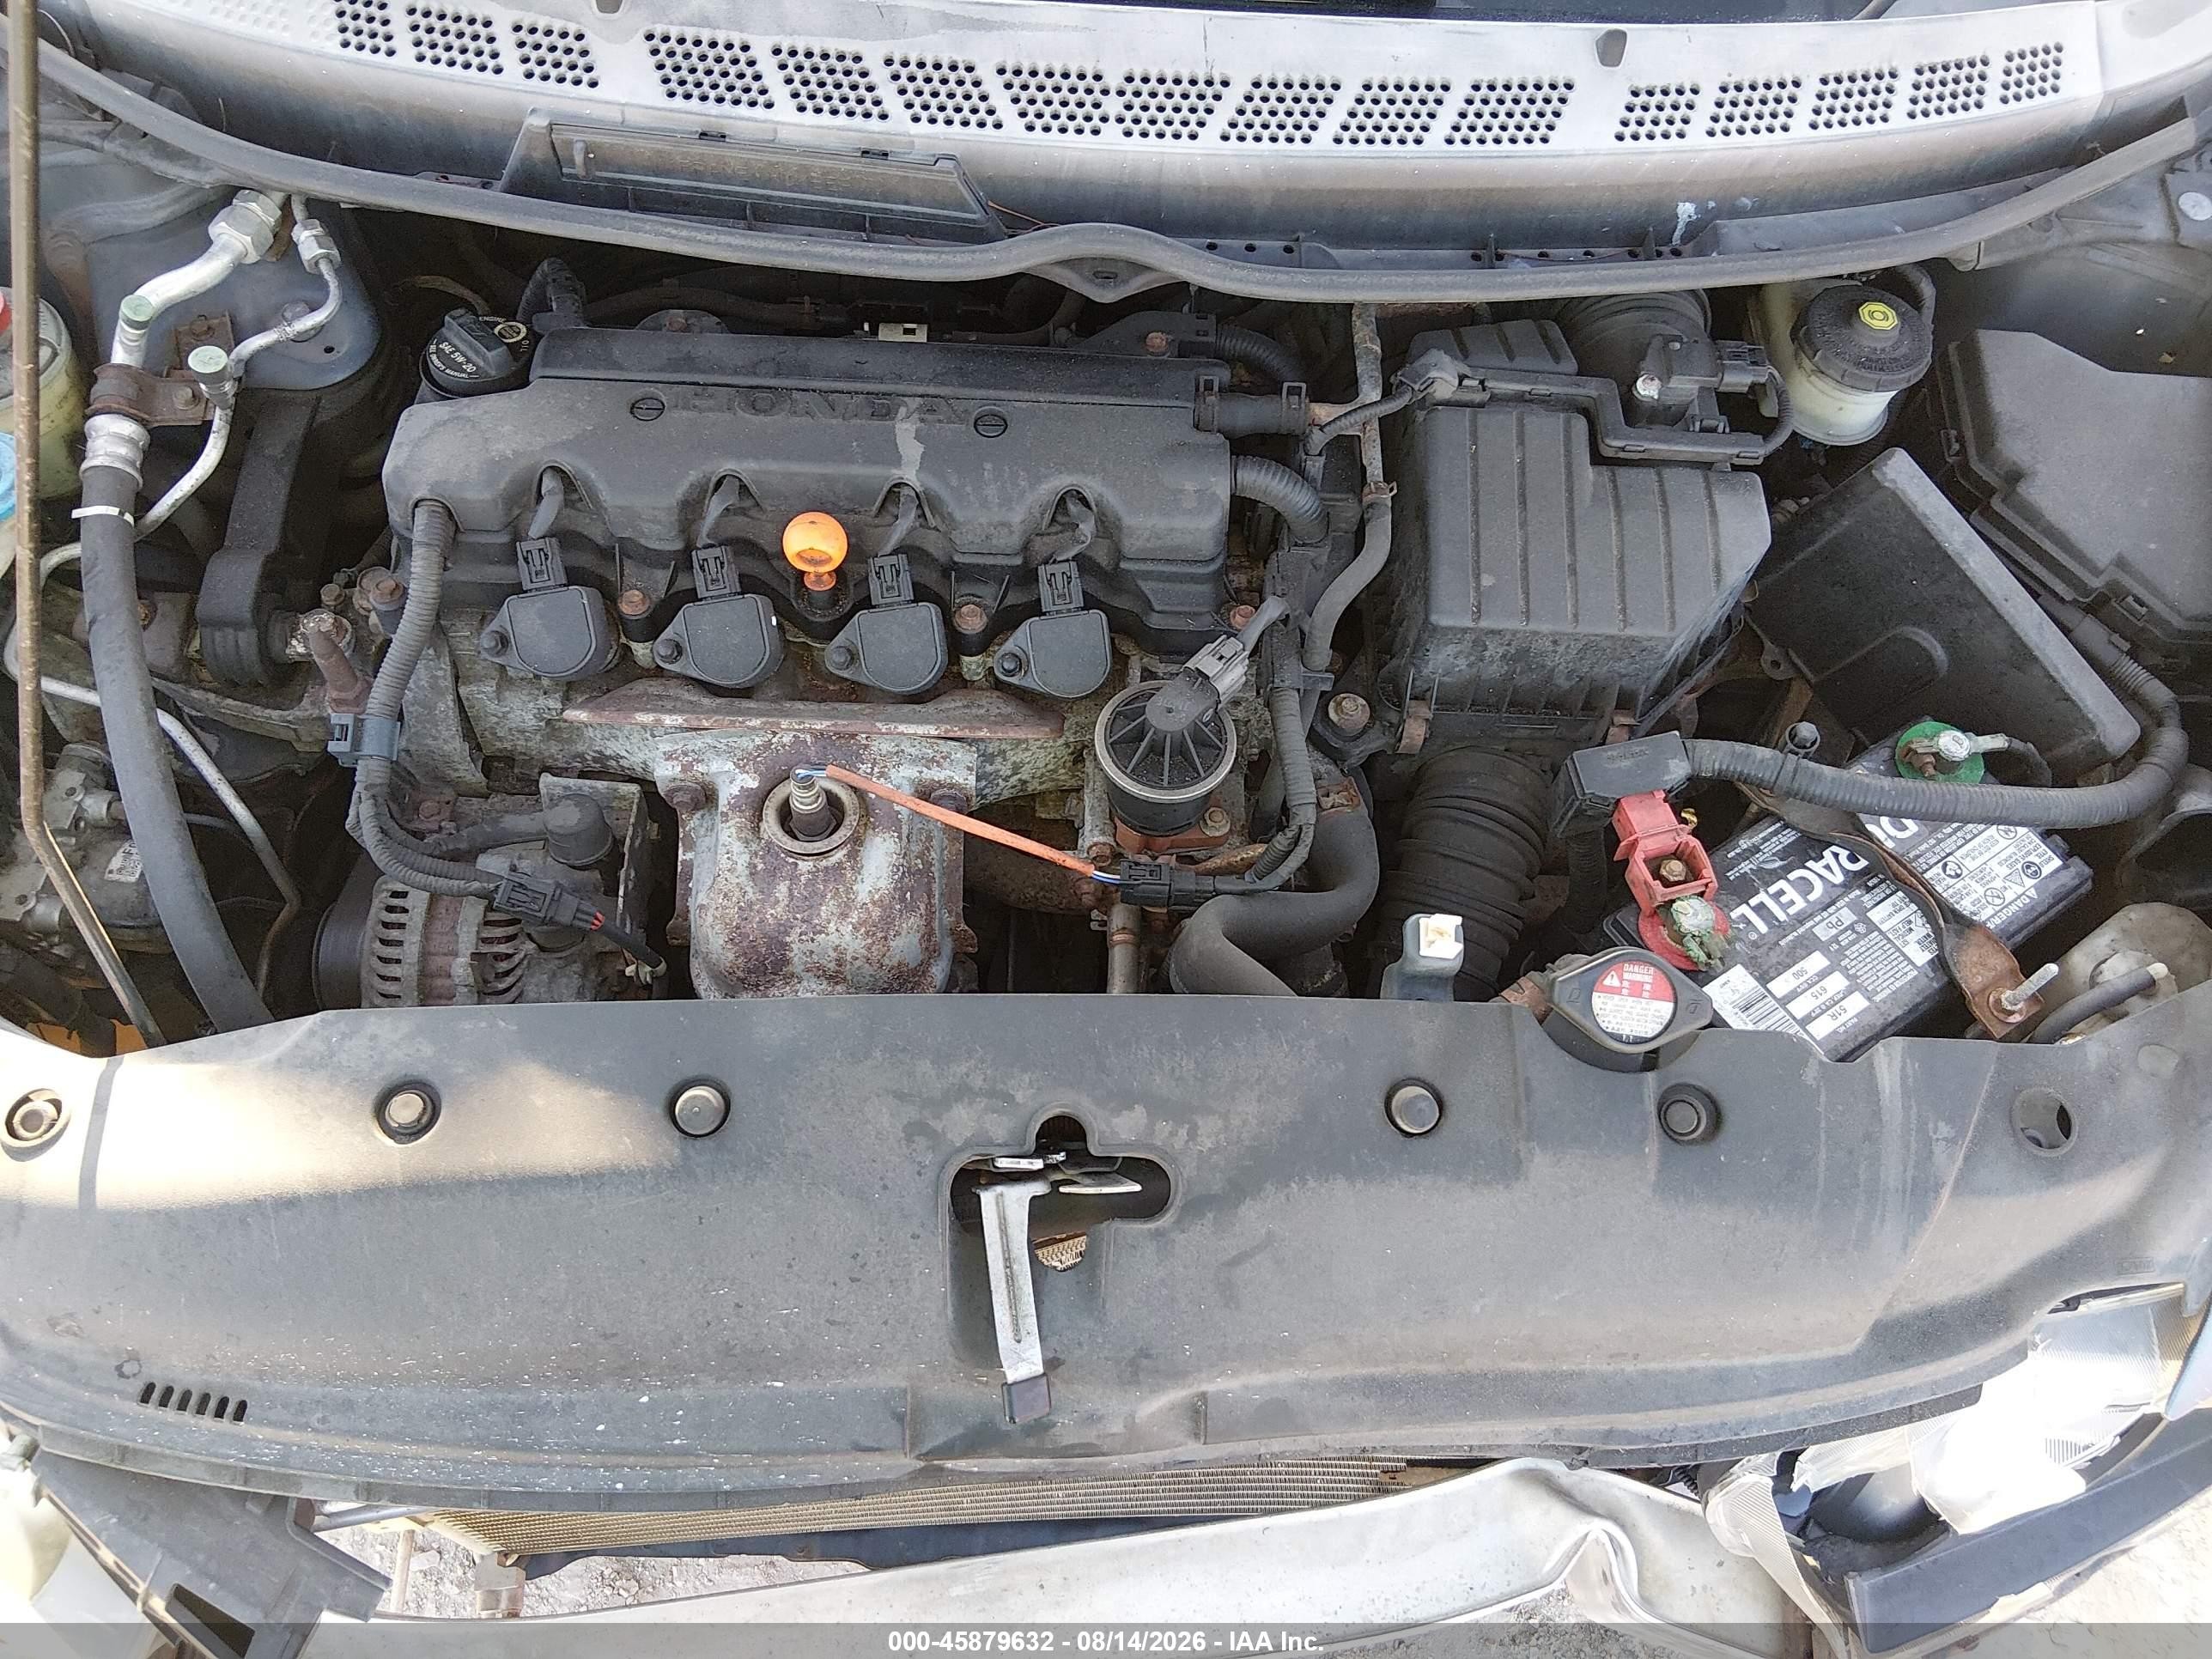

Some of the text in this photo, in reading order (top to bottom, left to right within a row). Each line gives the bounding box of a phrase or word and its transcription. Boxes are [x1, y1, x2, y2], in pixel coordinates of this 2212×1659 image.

[520, 339, 530, 352] OIL
[438, 340, 477, 373] SAE 5W-20
[445, 368, 469, 378] MANUAL
[678, 388, 969, 426] HONDA
[1825, 915, 1844, 932] Pb
[1622, 963, 1655, 975] DANGER
[1791, 966, 1808, 980] 500
[1809, 985, 1828, 1000] 615
[1826, 1004, 1848, 1022] 51R
[1844, 1016, 1858, 1028] PART
